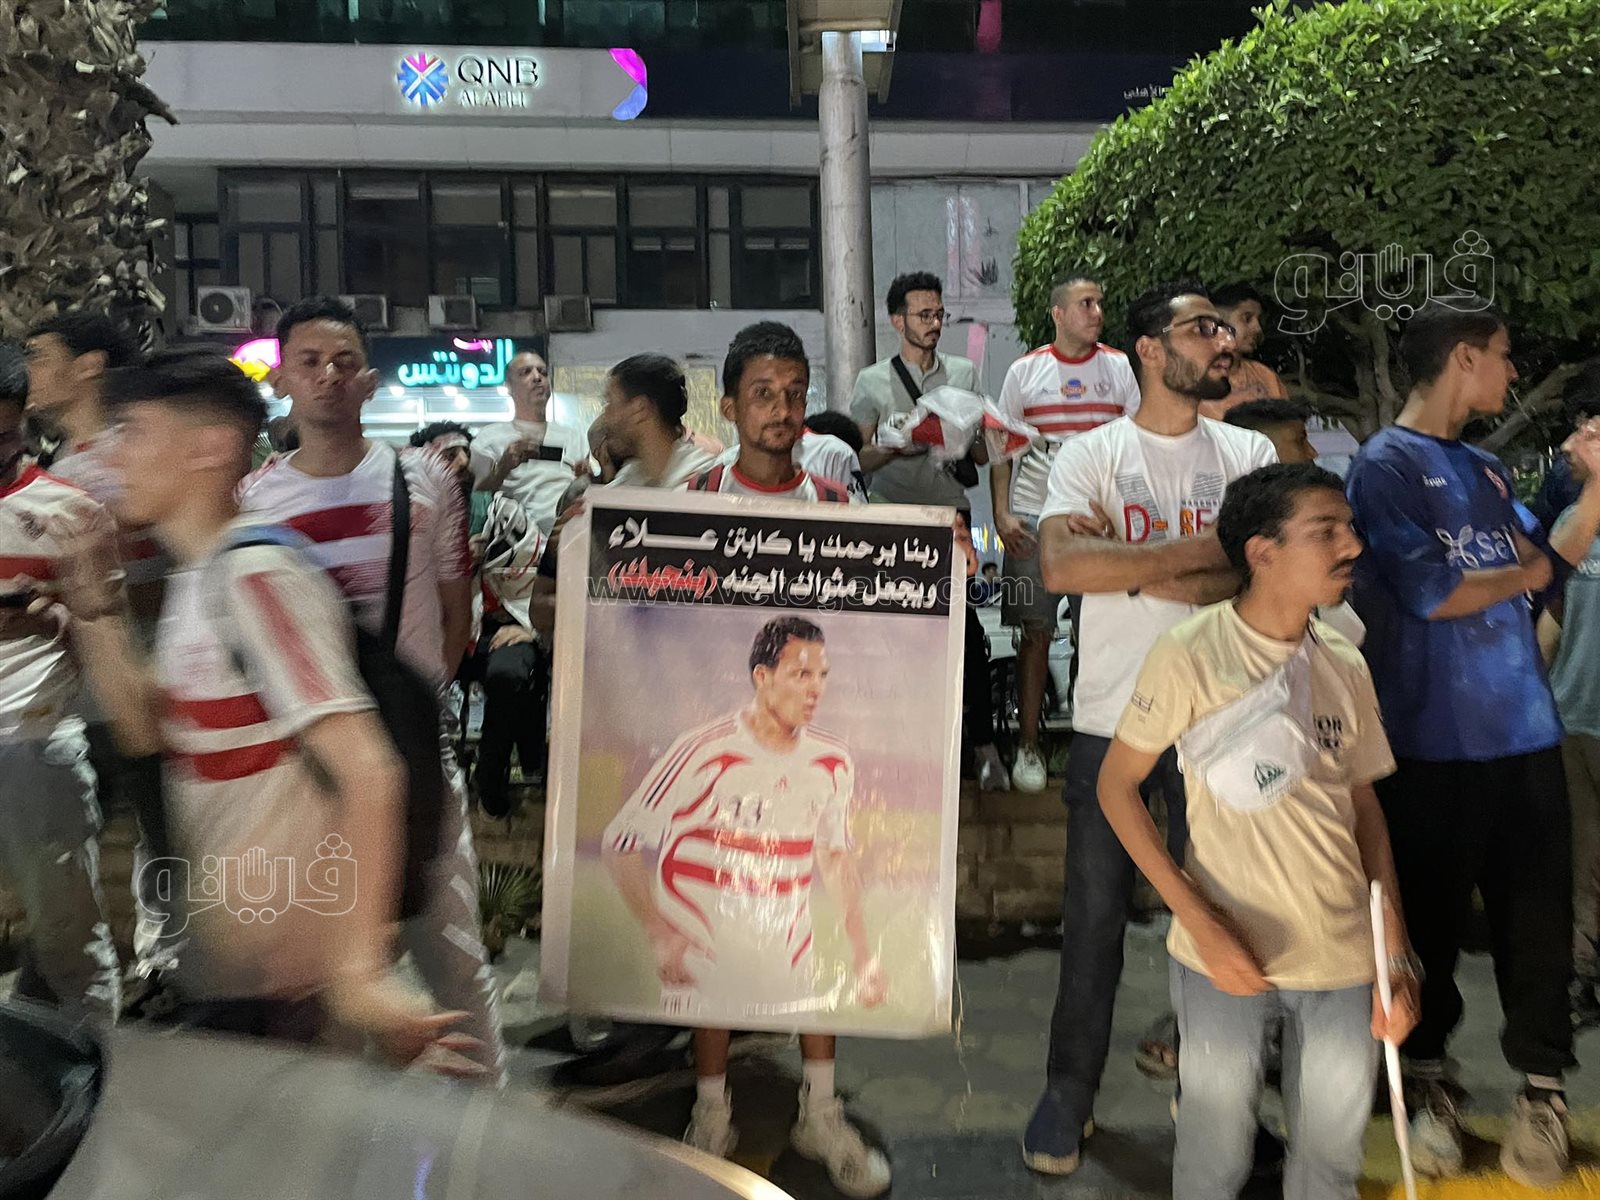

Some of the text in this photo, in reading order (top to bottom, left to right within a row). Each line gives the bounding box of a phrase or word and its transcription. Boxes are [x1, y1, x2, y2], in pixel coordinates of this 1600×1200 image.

[457, 56, 539, 87] QNB
[397, 338, 513, 391] الدونتس
[608, 516, 939, 569] ربنا يرحمك يا كابتن علاء
[789, 565, 858, 605] مثواك
[862, 571, 938, 609] ويجعل
